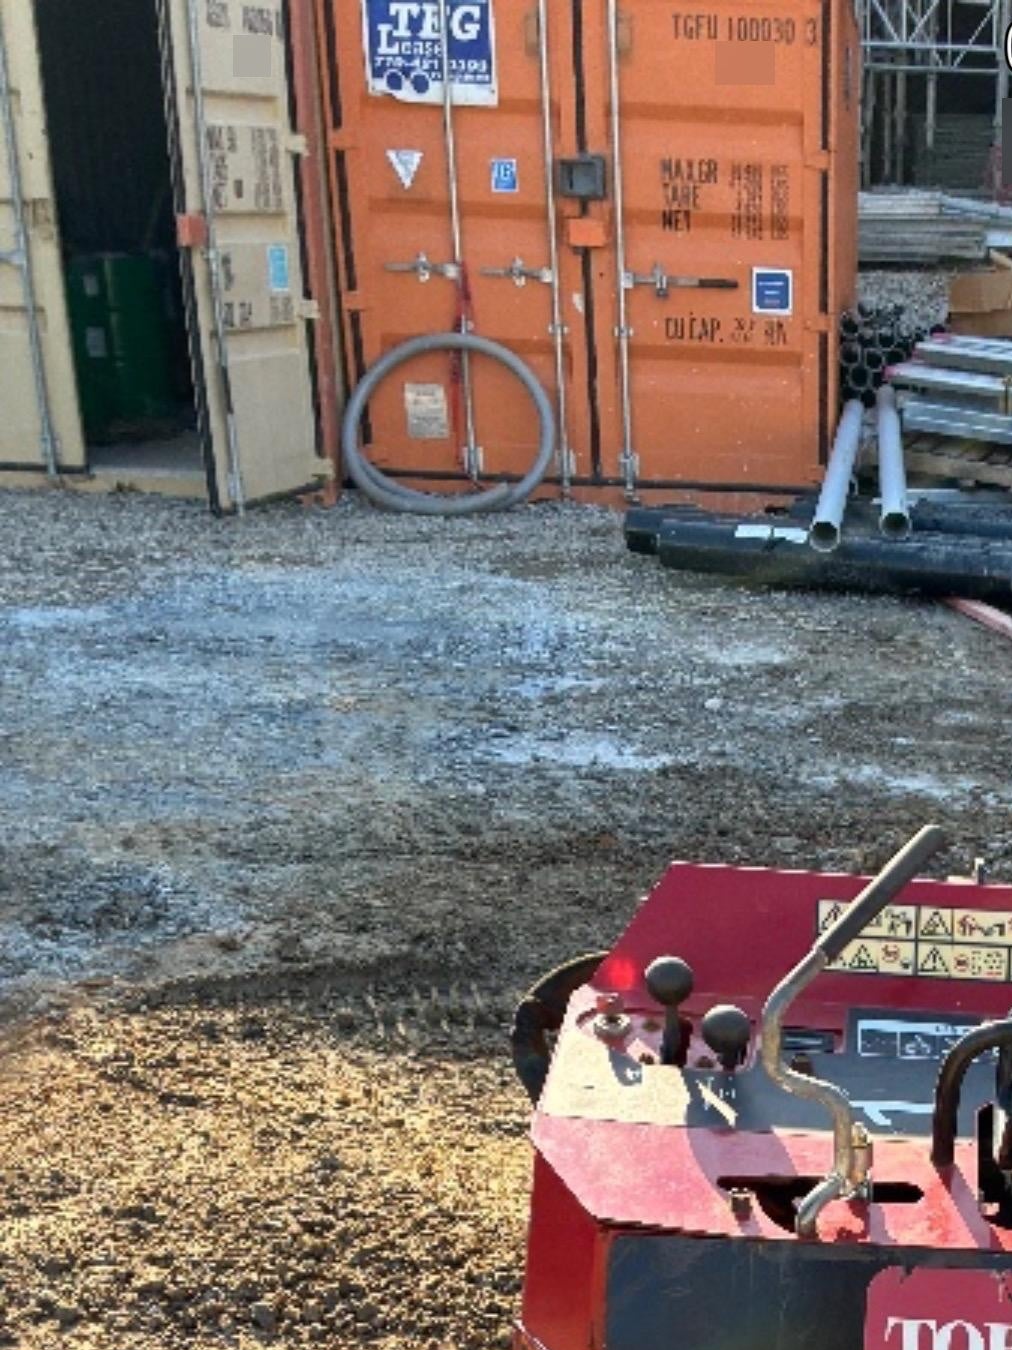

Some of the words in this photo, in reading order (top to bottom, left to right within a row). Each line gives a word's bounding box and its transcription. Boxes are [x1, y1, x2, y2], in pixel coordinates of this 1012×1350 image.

[672, 13, 718, 41] TGFU
[804, 18, 818, 46] 3
[661, 210, 691, 233] NET
